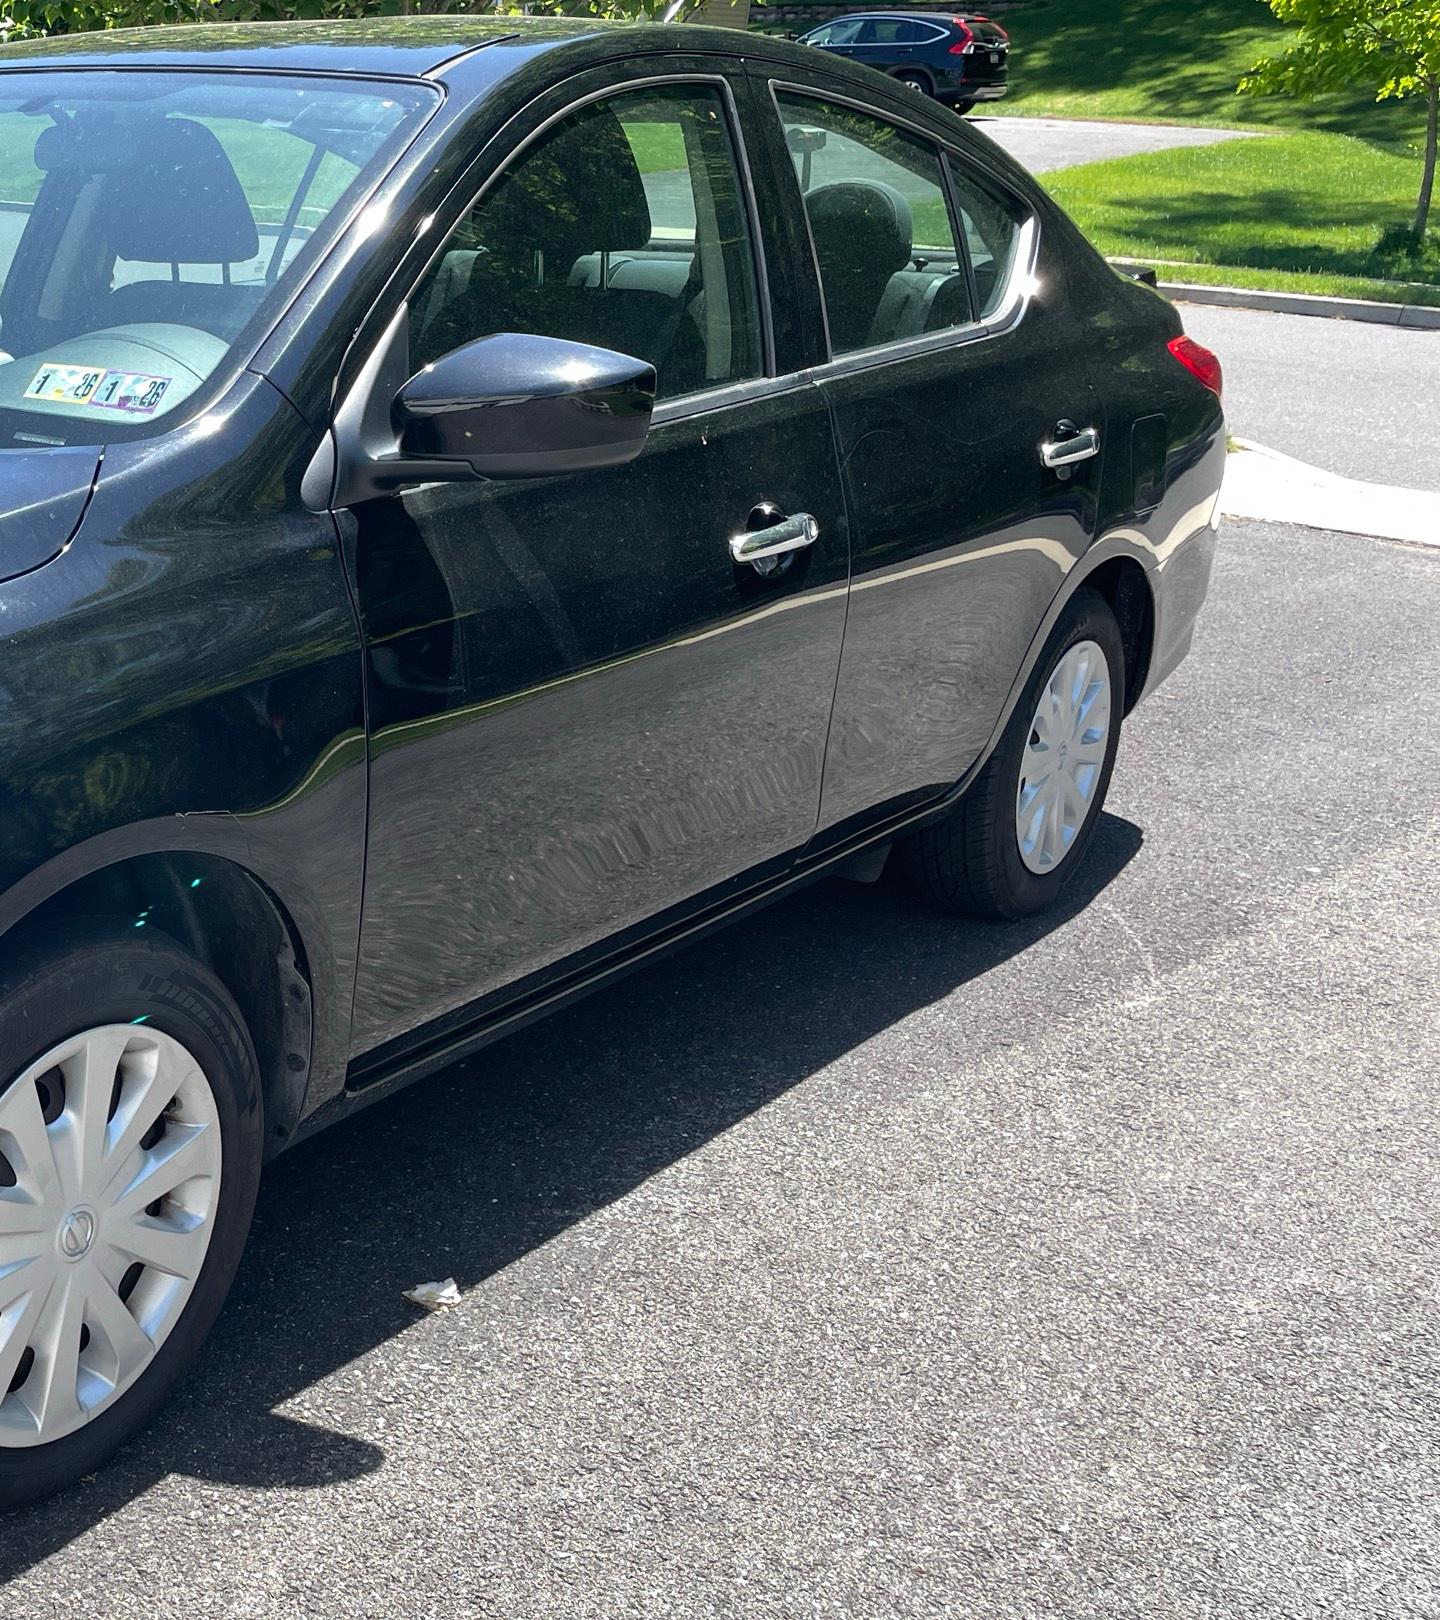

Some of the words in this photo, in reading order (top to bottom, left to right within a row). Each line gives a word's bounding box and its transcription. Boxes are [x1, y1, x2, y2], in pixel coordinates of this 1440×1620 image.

[35, 374, 50, 394] 1
[73, 373, 99, 397] 26
[104, 380, 119, 401] 1
[140, 381, 166, 407] 26
